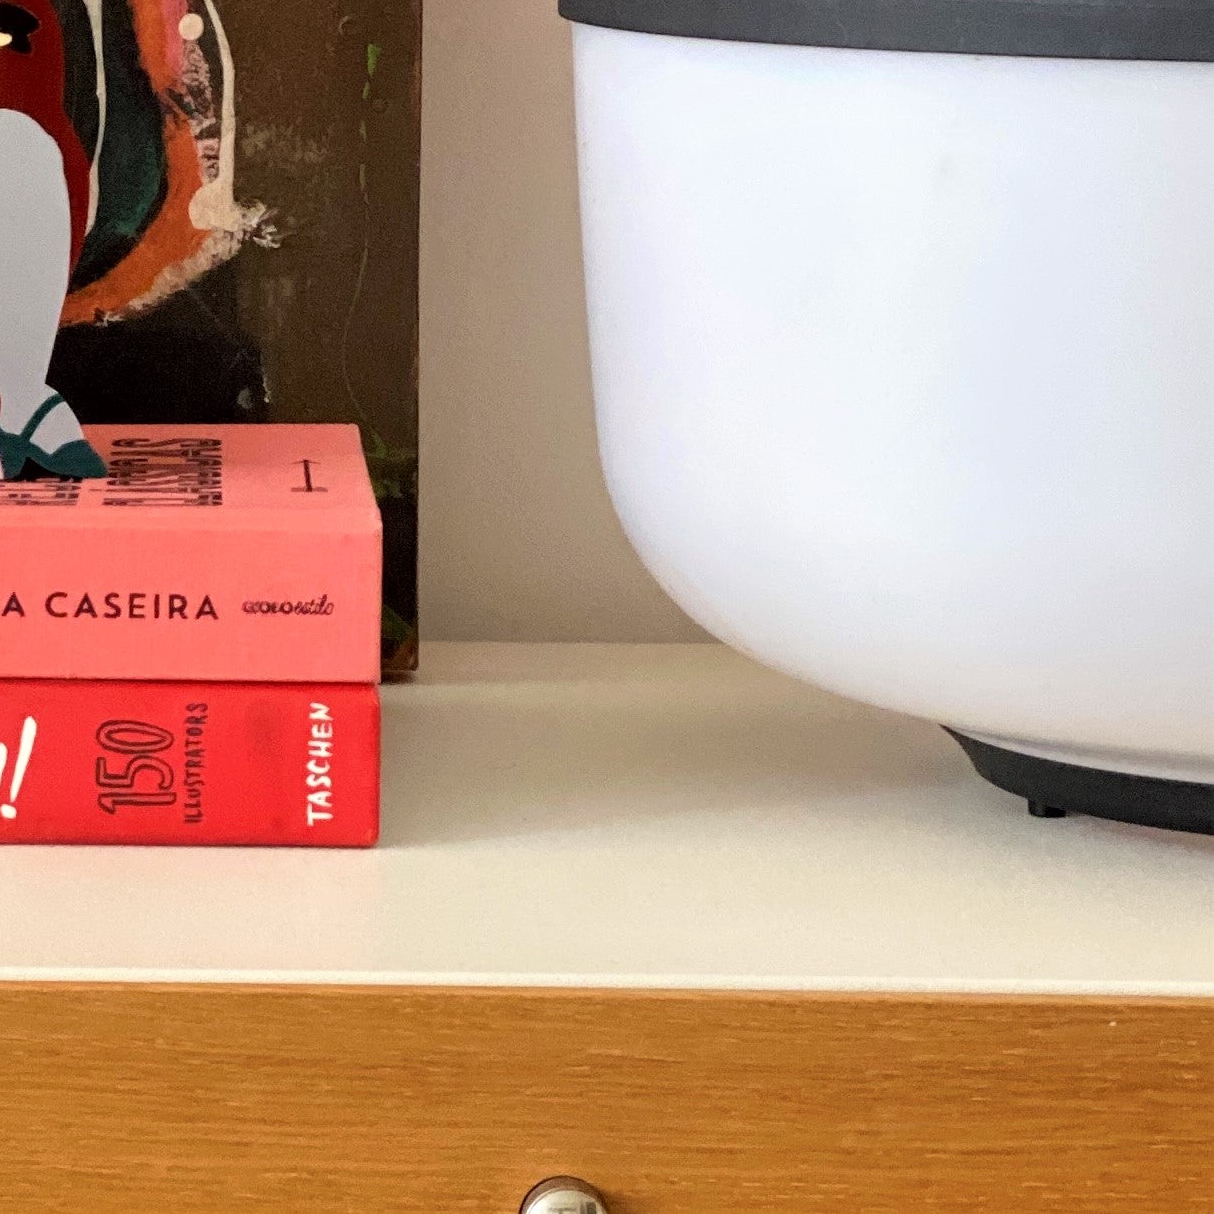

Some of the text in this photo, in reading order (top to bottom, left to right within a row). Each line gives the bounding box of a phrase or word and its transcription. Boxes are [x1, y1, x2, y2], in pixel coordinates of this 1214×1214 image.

[44, 591, 219, 620] CASEIRA
[94, 719, 178, 816] 150
[182, 702, 209, 824] ILLUSTRATORS
[306, 702, 334, 826] TASCHEN
